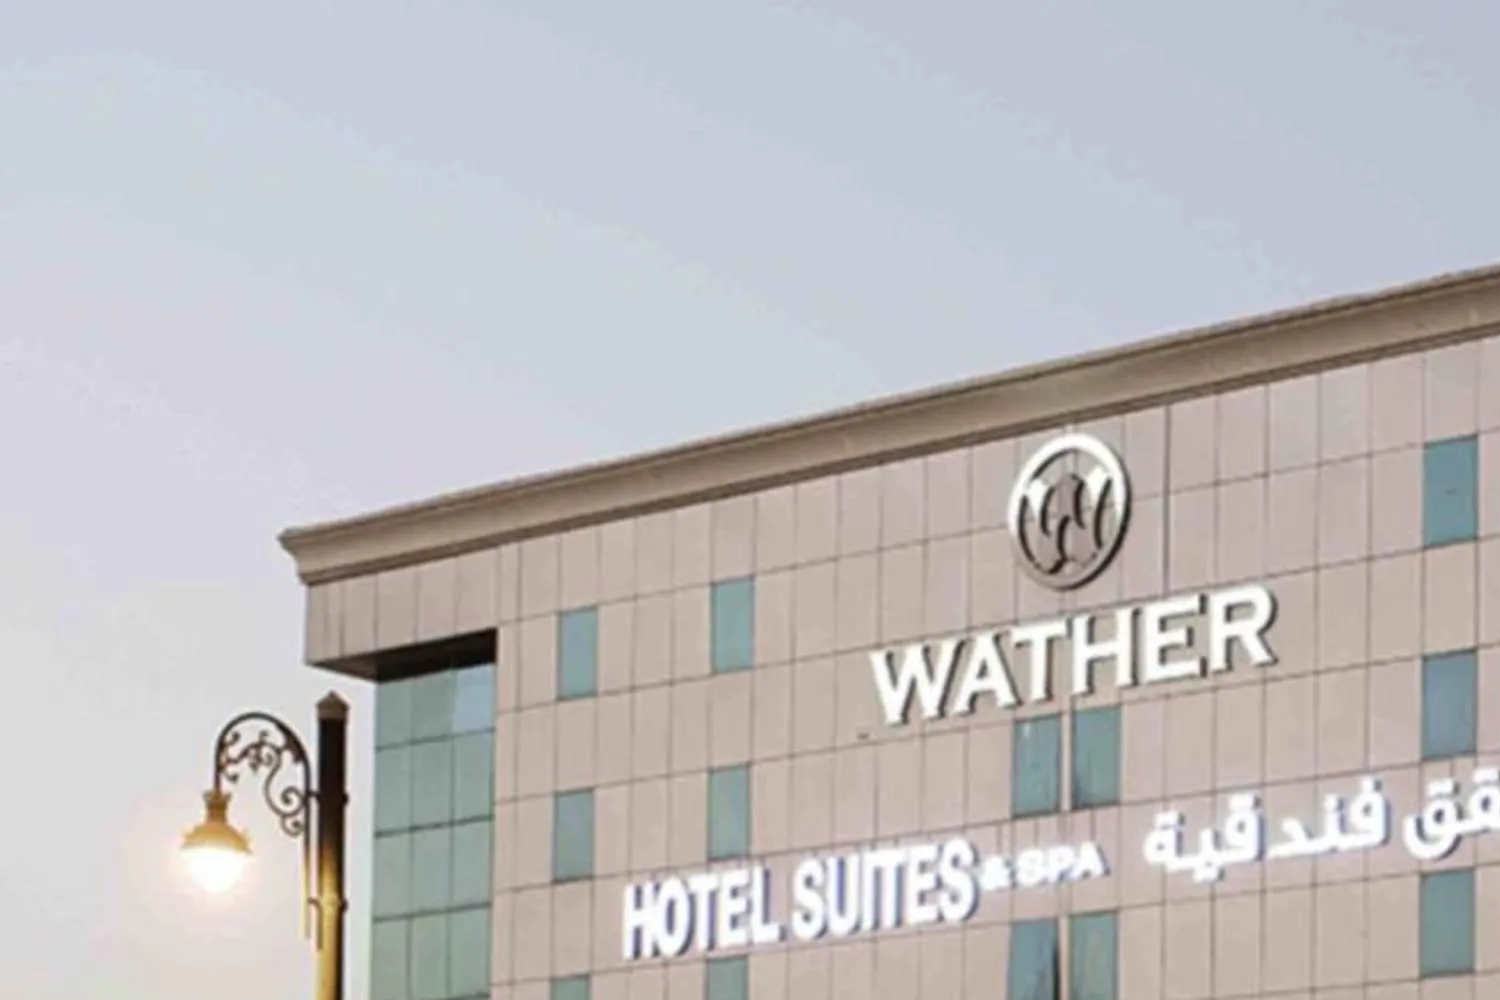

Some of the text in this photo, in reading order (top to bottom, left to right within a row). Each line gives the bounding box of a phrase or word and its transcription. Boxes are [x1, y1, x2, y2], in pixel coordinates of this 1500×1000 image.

[869, 583, 1278, 726] WATHER
[1143, 774, 1391, 882] فندقية
[623, 837, 1109, 960] HOTEL SUITES & SPA
